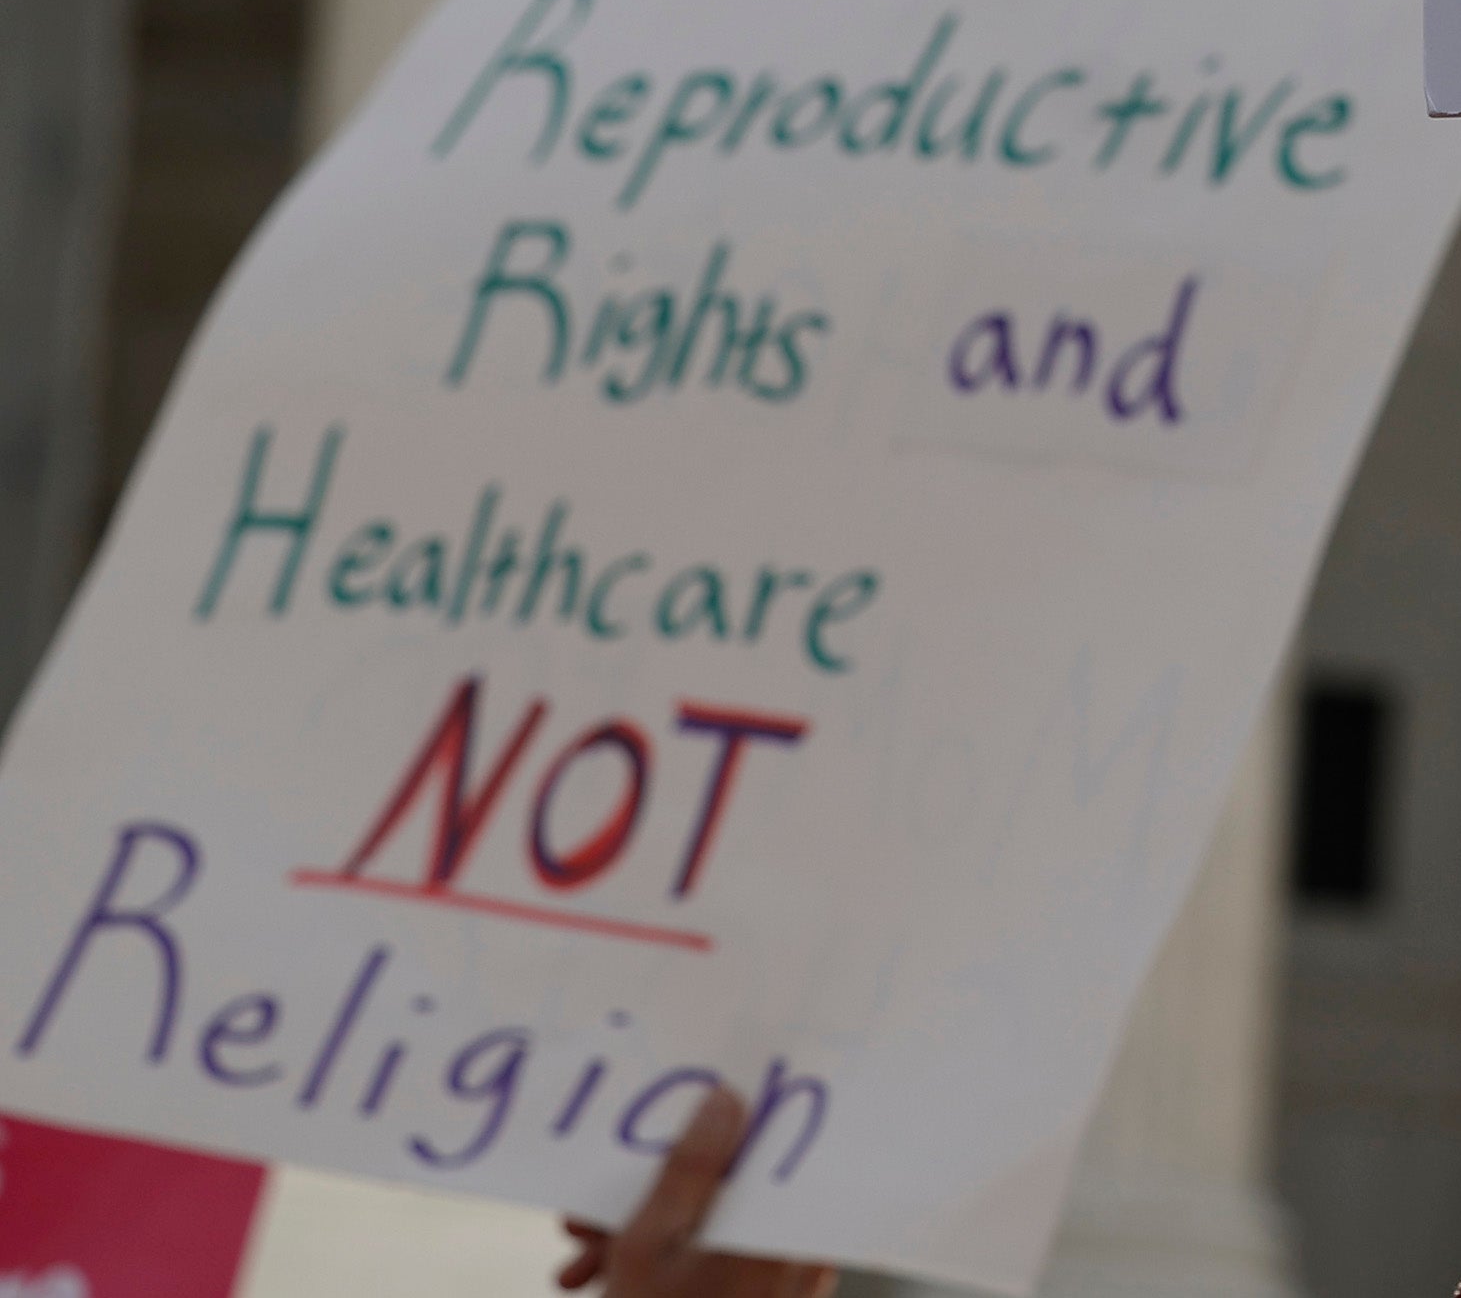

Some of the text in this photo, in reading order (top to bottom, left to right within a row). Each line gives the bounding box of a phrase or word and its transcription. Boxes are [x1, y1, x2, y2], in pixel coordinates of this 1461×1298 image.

[445, 219, 1202, 425] Rights and
[193, 423, 882, 675] Healthcare
[340, 673, 812, 900] NOT
[14, 821, 832, 1183] Religion
